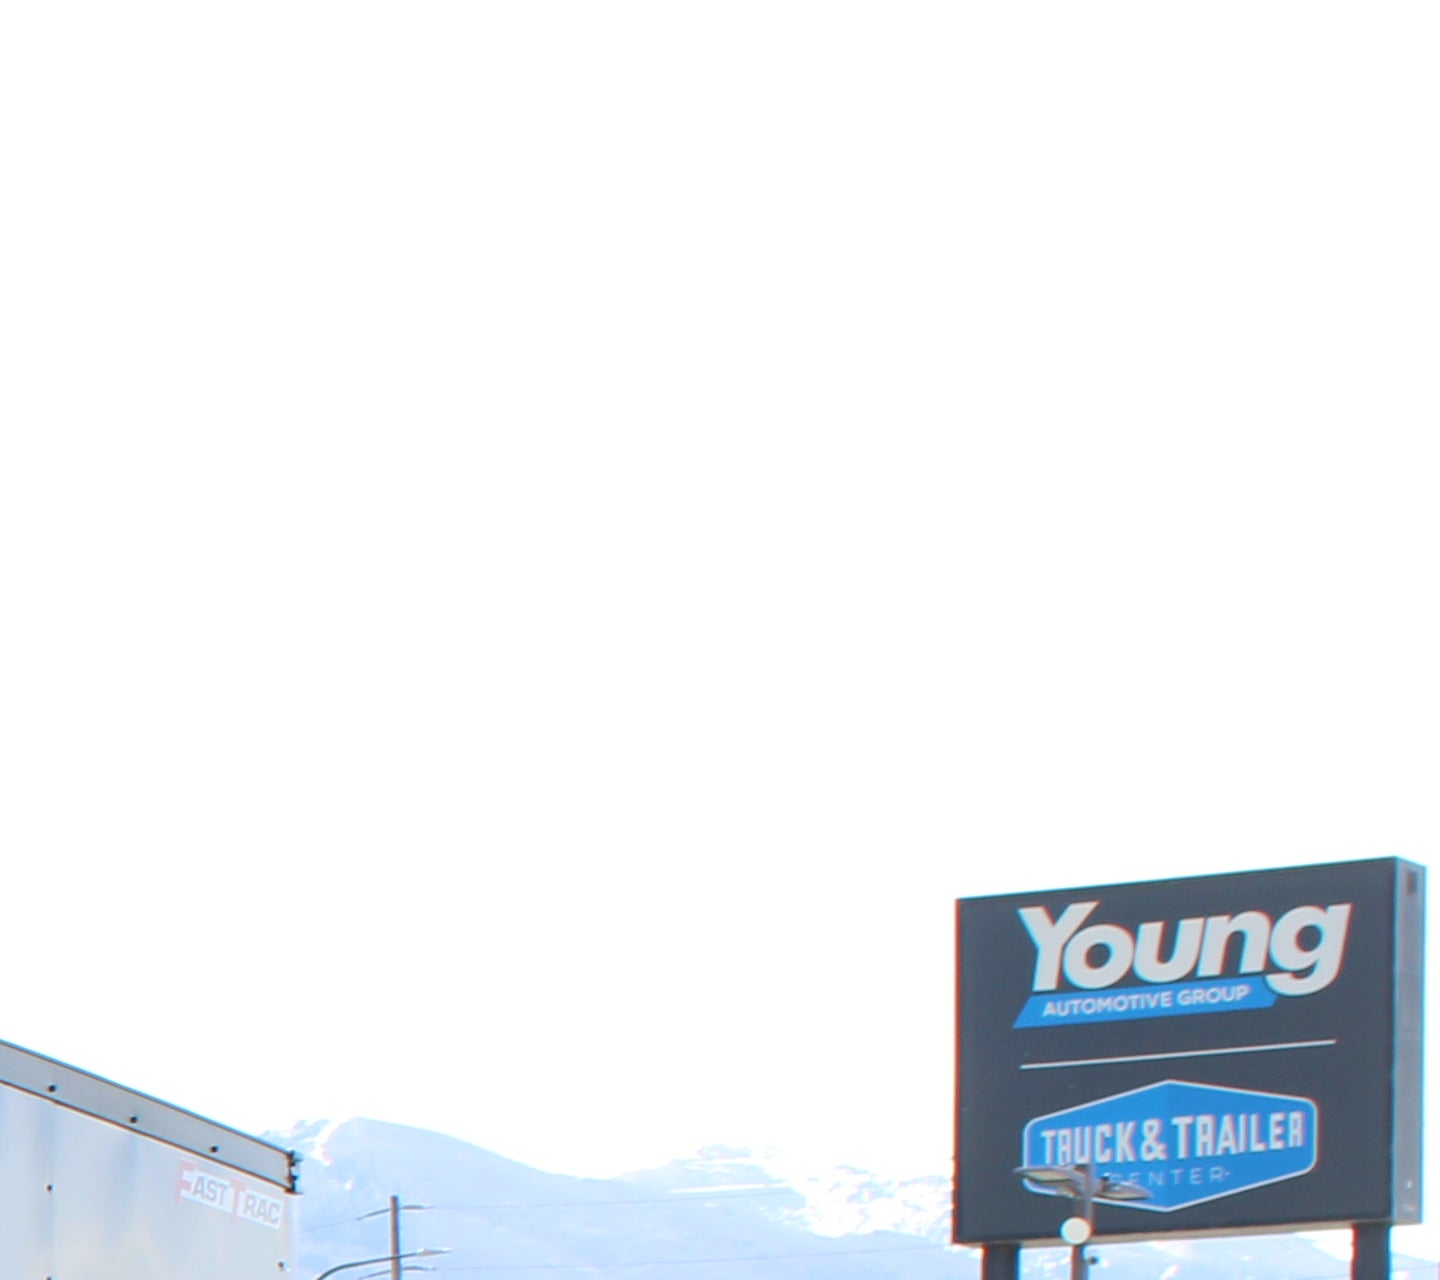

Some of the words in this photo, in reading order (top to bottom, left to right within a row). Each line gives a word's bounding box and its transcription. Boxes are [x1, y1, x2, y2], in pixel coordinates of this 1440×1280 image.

[1017, 900, 1353, 997] Young
[1042, 990, 1173, 1018] AUTOMOTIVE
[1176, 984, 1251, 1006] GROUP
[1040, 1121, 1137, 1166] TRUCK
[1140, 1117, 1168, 1162] &
[1171, 1110, 1307, 1160] TRAILER
